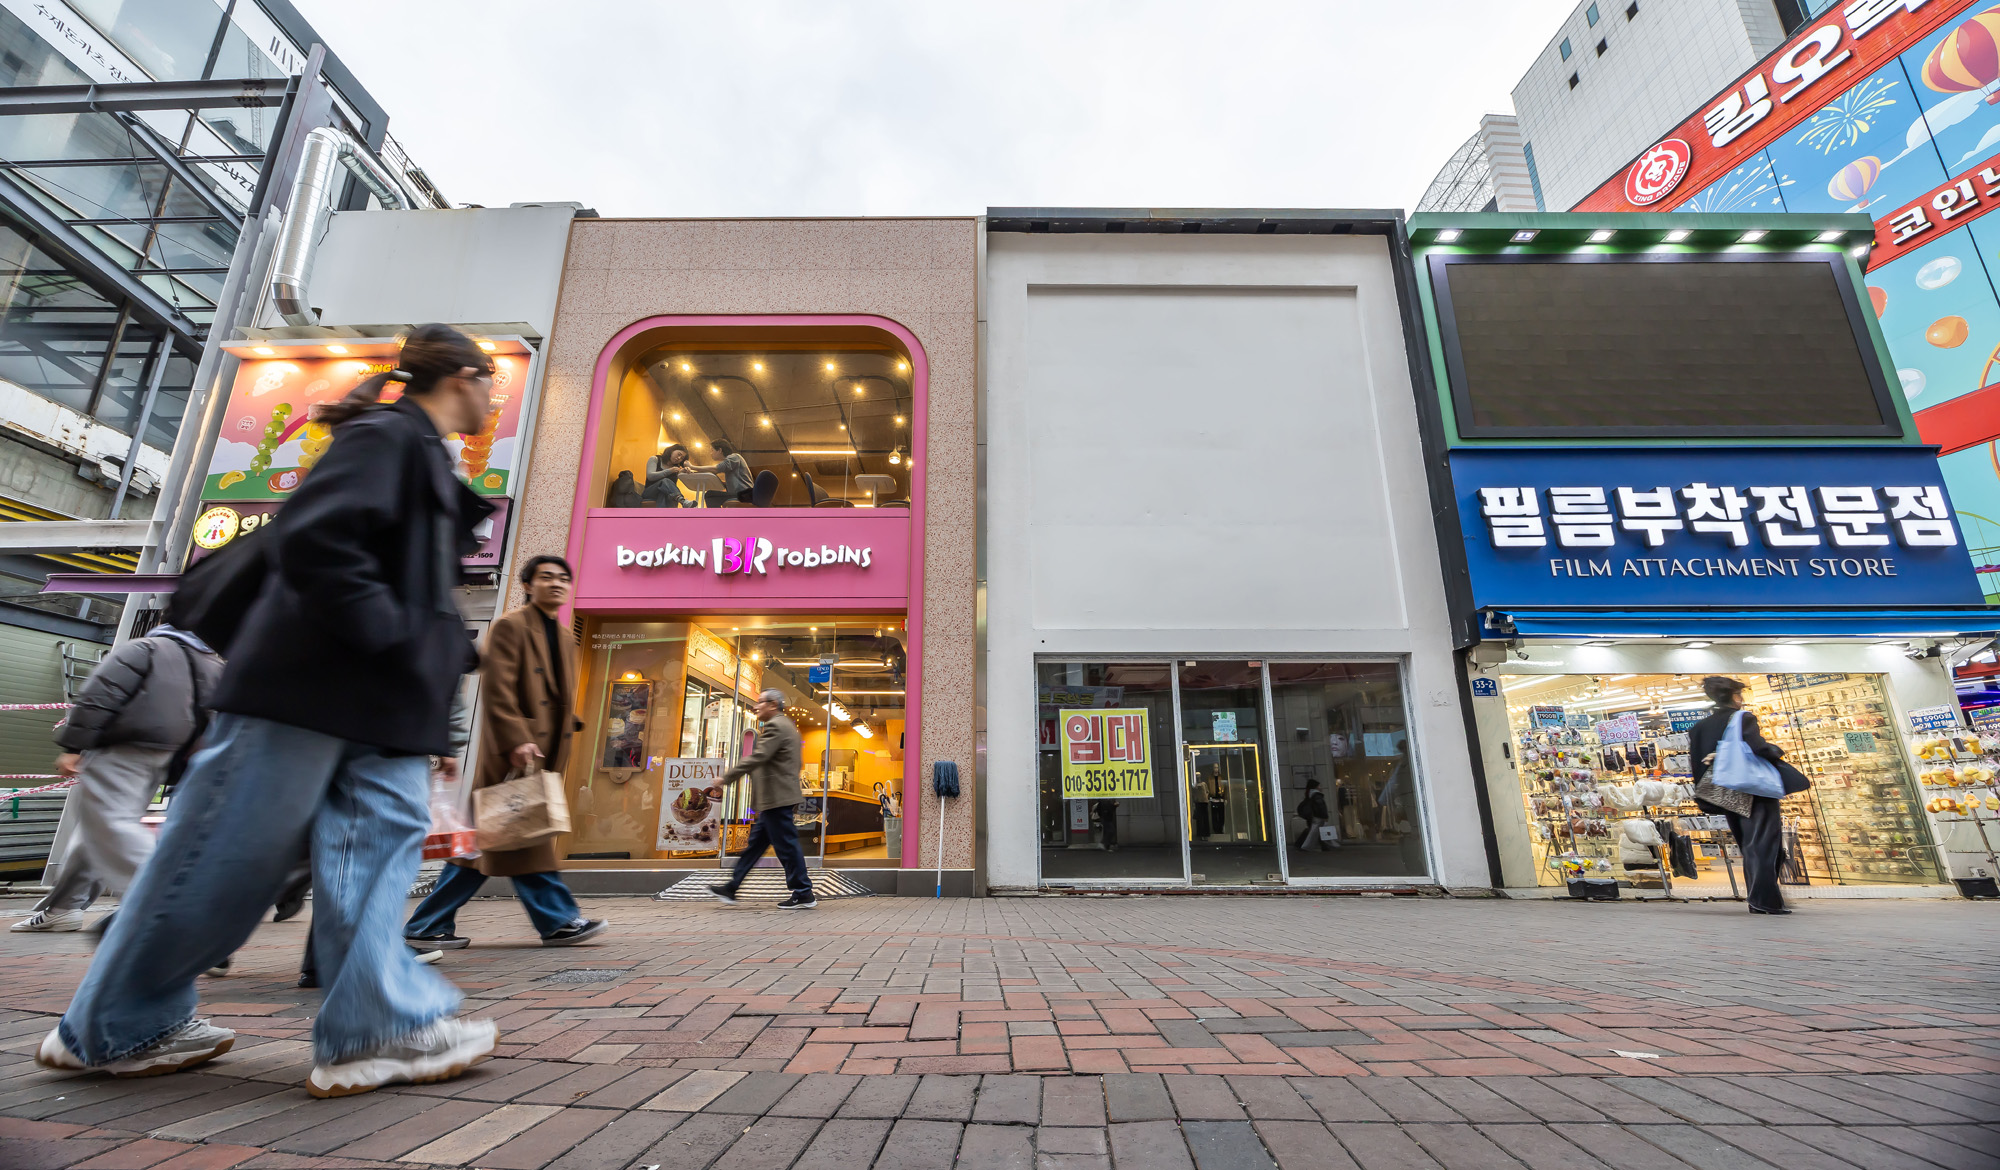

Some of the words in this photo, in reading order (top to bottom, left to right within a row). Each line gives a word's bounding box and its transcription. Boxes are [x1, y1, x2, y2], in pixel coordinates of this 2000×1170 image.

[33, 3, 105, 68] 수제돈카츠
[1633, 194, 1653, 202] KING
[1656, 160, 1686, 198] ARCADE
[1480, 482, 1959, 548] 필름부착전문점
[1549, 558, 1614, 578] FILM
[1622, 557, 1801, 578] ATTACHMENT
[1811, 557, 1899, 578] STORE
[1475, 680, 1494, 689] 33-2
[1064, 713, 1147, 765] 임대
[669, 764, 721, 780] DUBAI
[1064, 768, 1149, 793] 010-3513-1717
